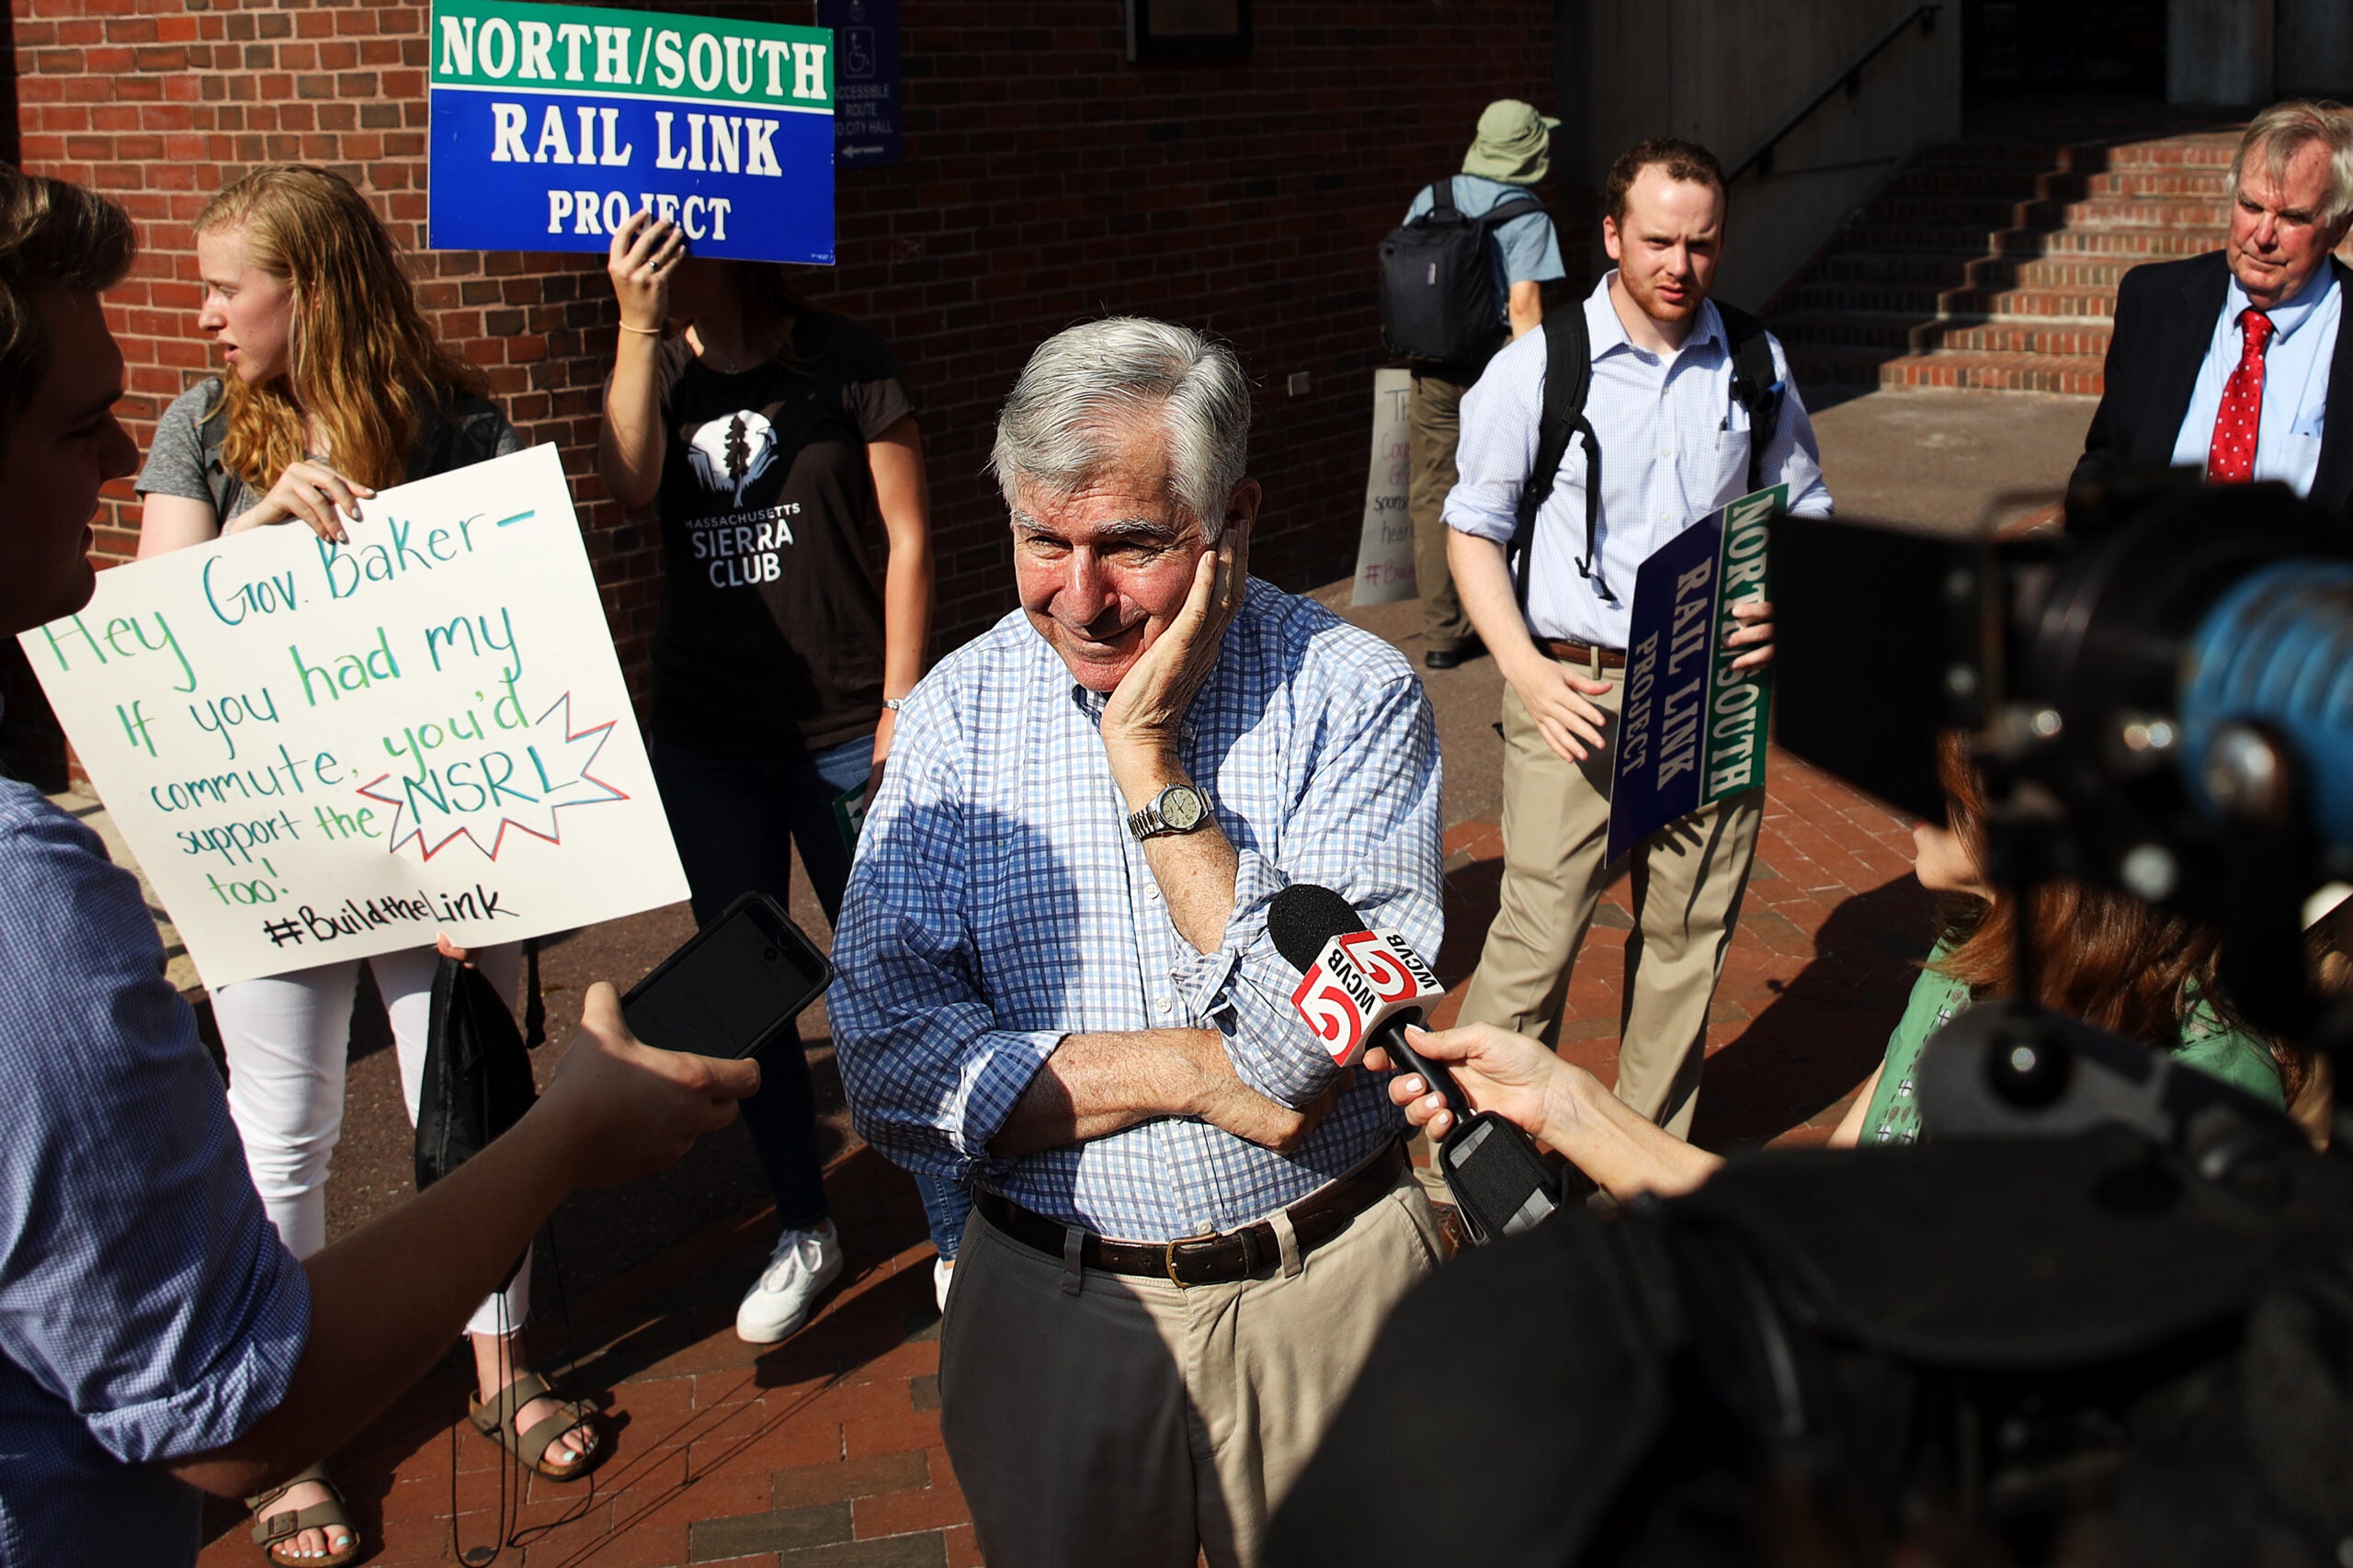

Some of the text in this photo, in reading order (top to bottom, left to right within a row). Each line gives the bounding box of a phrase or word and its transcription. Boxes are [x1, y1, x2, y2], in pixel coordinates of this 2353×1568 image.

[438, 15, 827, 100] NORTH/SOUTH
[491, 102, 782, 177] RAIL LINK
[835, 119, 893, 136] O CITY HALL
[846, 102, 878, 117] ROUTE
[684, 502, 801, 530] MASSACHUSETTS
[692, 517, 795, 559] SIERRA
[709, 551, 782, 588] CLUB
[41, 611, 197, 692] Hey
[189, 687, 279, 760] you
[289, 626, 401, 707] had
[426, 607, 521, 683] my
[1657, 556, 1712, 791] RAIL LINK
[382, 666, 529, 785] you'd
[1622, 631, 1659, 778] PROJECT
[176, 745, 580, 865] support the NSRL
[206, 857, 290, 905] too!
[1327, 949, 1376, 1016] WCVB
[1339, 930, 1417, 1003] 5
[1386, 934, 1438, 989] WCVB
[1290, 962, 1362, 1066] 5
